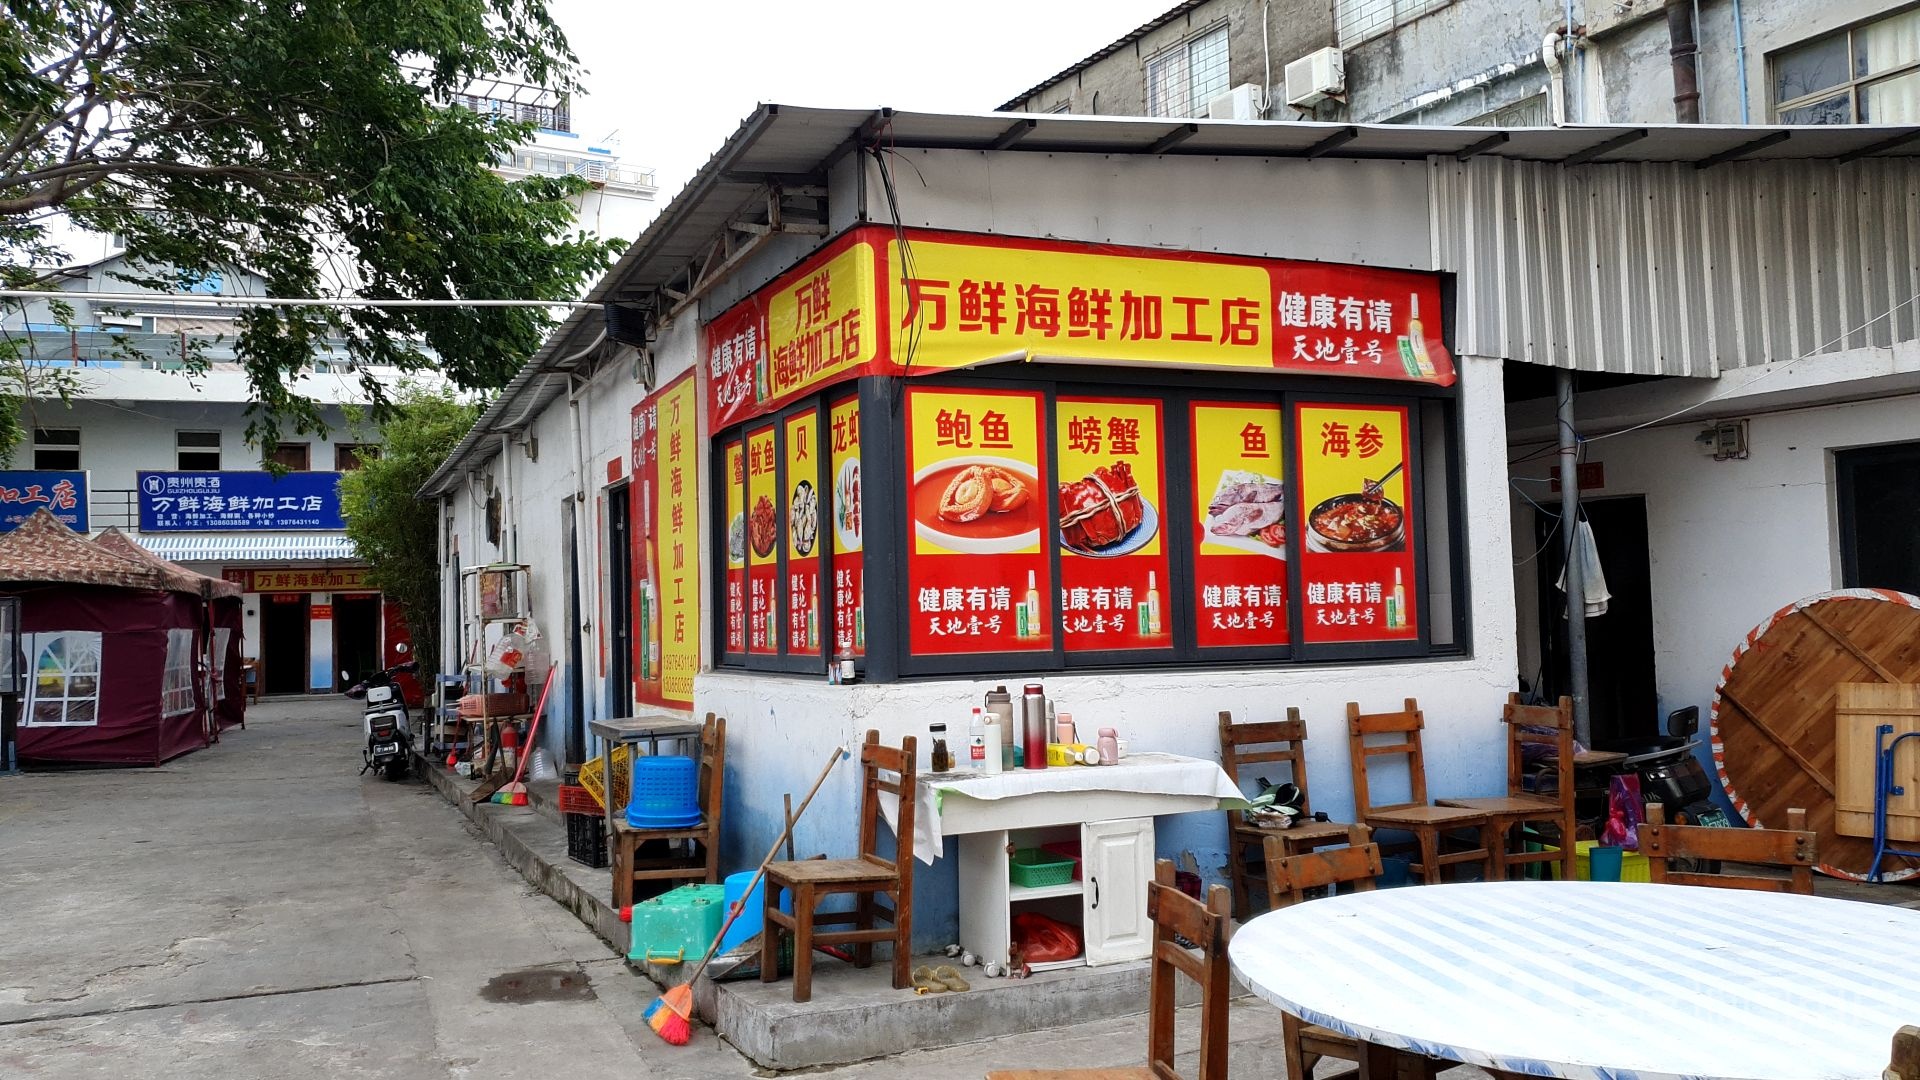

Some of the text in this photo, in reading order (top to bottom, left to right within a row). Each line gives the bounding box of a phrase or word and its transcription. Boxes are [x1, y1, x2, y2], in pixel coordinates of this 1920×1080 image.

[795, 269, 831, 334] 万鲜
[899, 278, 1261, 347] 万鲜海鲜加工店
[1277, 291, 1393, 334] 健康有请
[711, 325, 756, 380] 健康有请
[773, 308, 861, 392] 海鲜加工店
[1292, 335, 1384, 365] 天地壹号
[633, 405, 657, 441] 健康请
[935, 408, 1013, 449] 鲍鱼
[1068, 415, 1140, 455] 螃蟹
[1240, 422, 1270, 459] 鱼
[1320, 421, 1384, 459] 海参
[751, 439, 774, 476] 鱿鱼
[797, 425, 808, 462] 贝
[167, 477, 220, 488] 贵州贵酒
[151, 495, 323, 513] 万鲜海鲜加工店
[670, 395, 685, 644] 万鲜海鲜加工店
[258, 573, 360, 587] 万鲜海鲜加工
[1202, 584, 1281, 608] 健康有请
[1307, 582, 1382, 605] 健康有请
[918, 586, 1011, 612] 健康有请
[1062, 586, 1133, 611] 康有请
[929, 614, 1003, 636] 天地壹号
[1212, 611, 1275, 630] 天地壹号
[1316, 608, 1376, 626] 天地壹号
[663, 676, 693, 694] 1308603858
